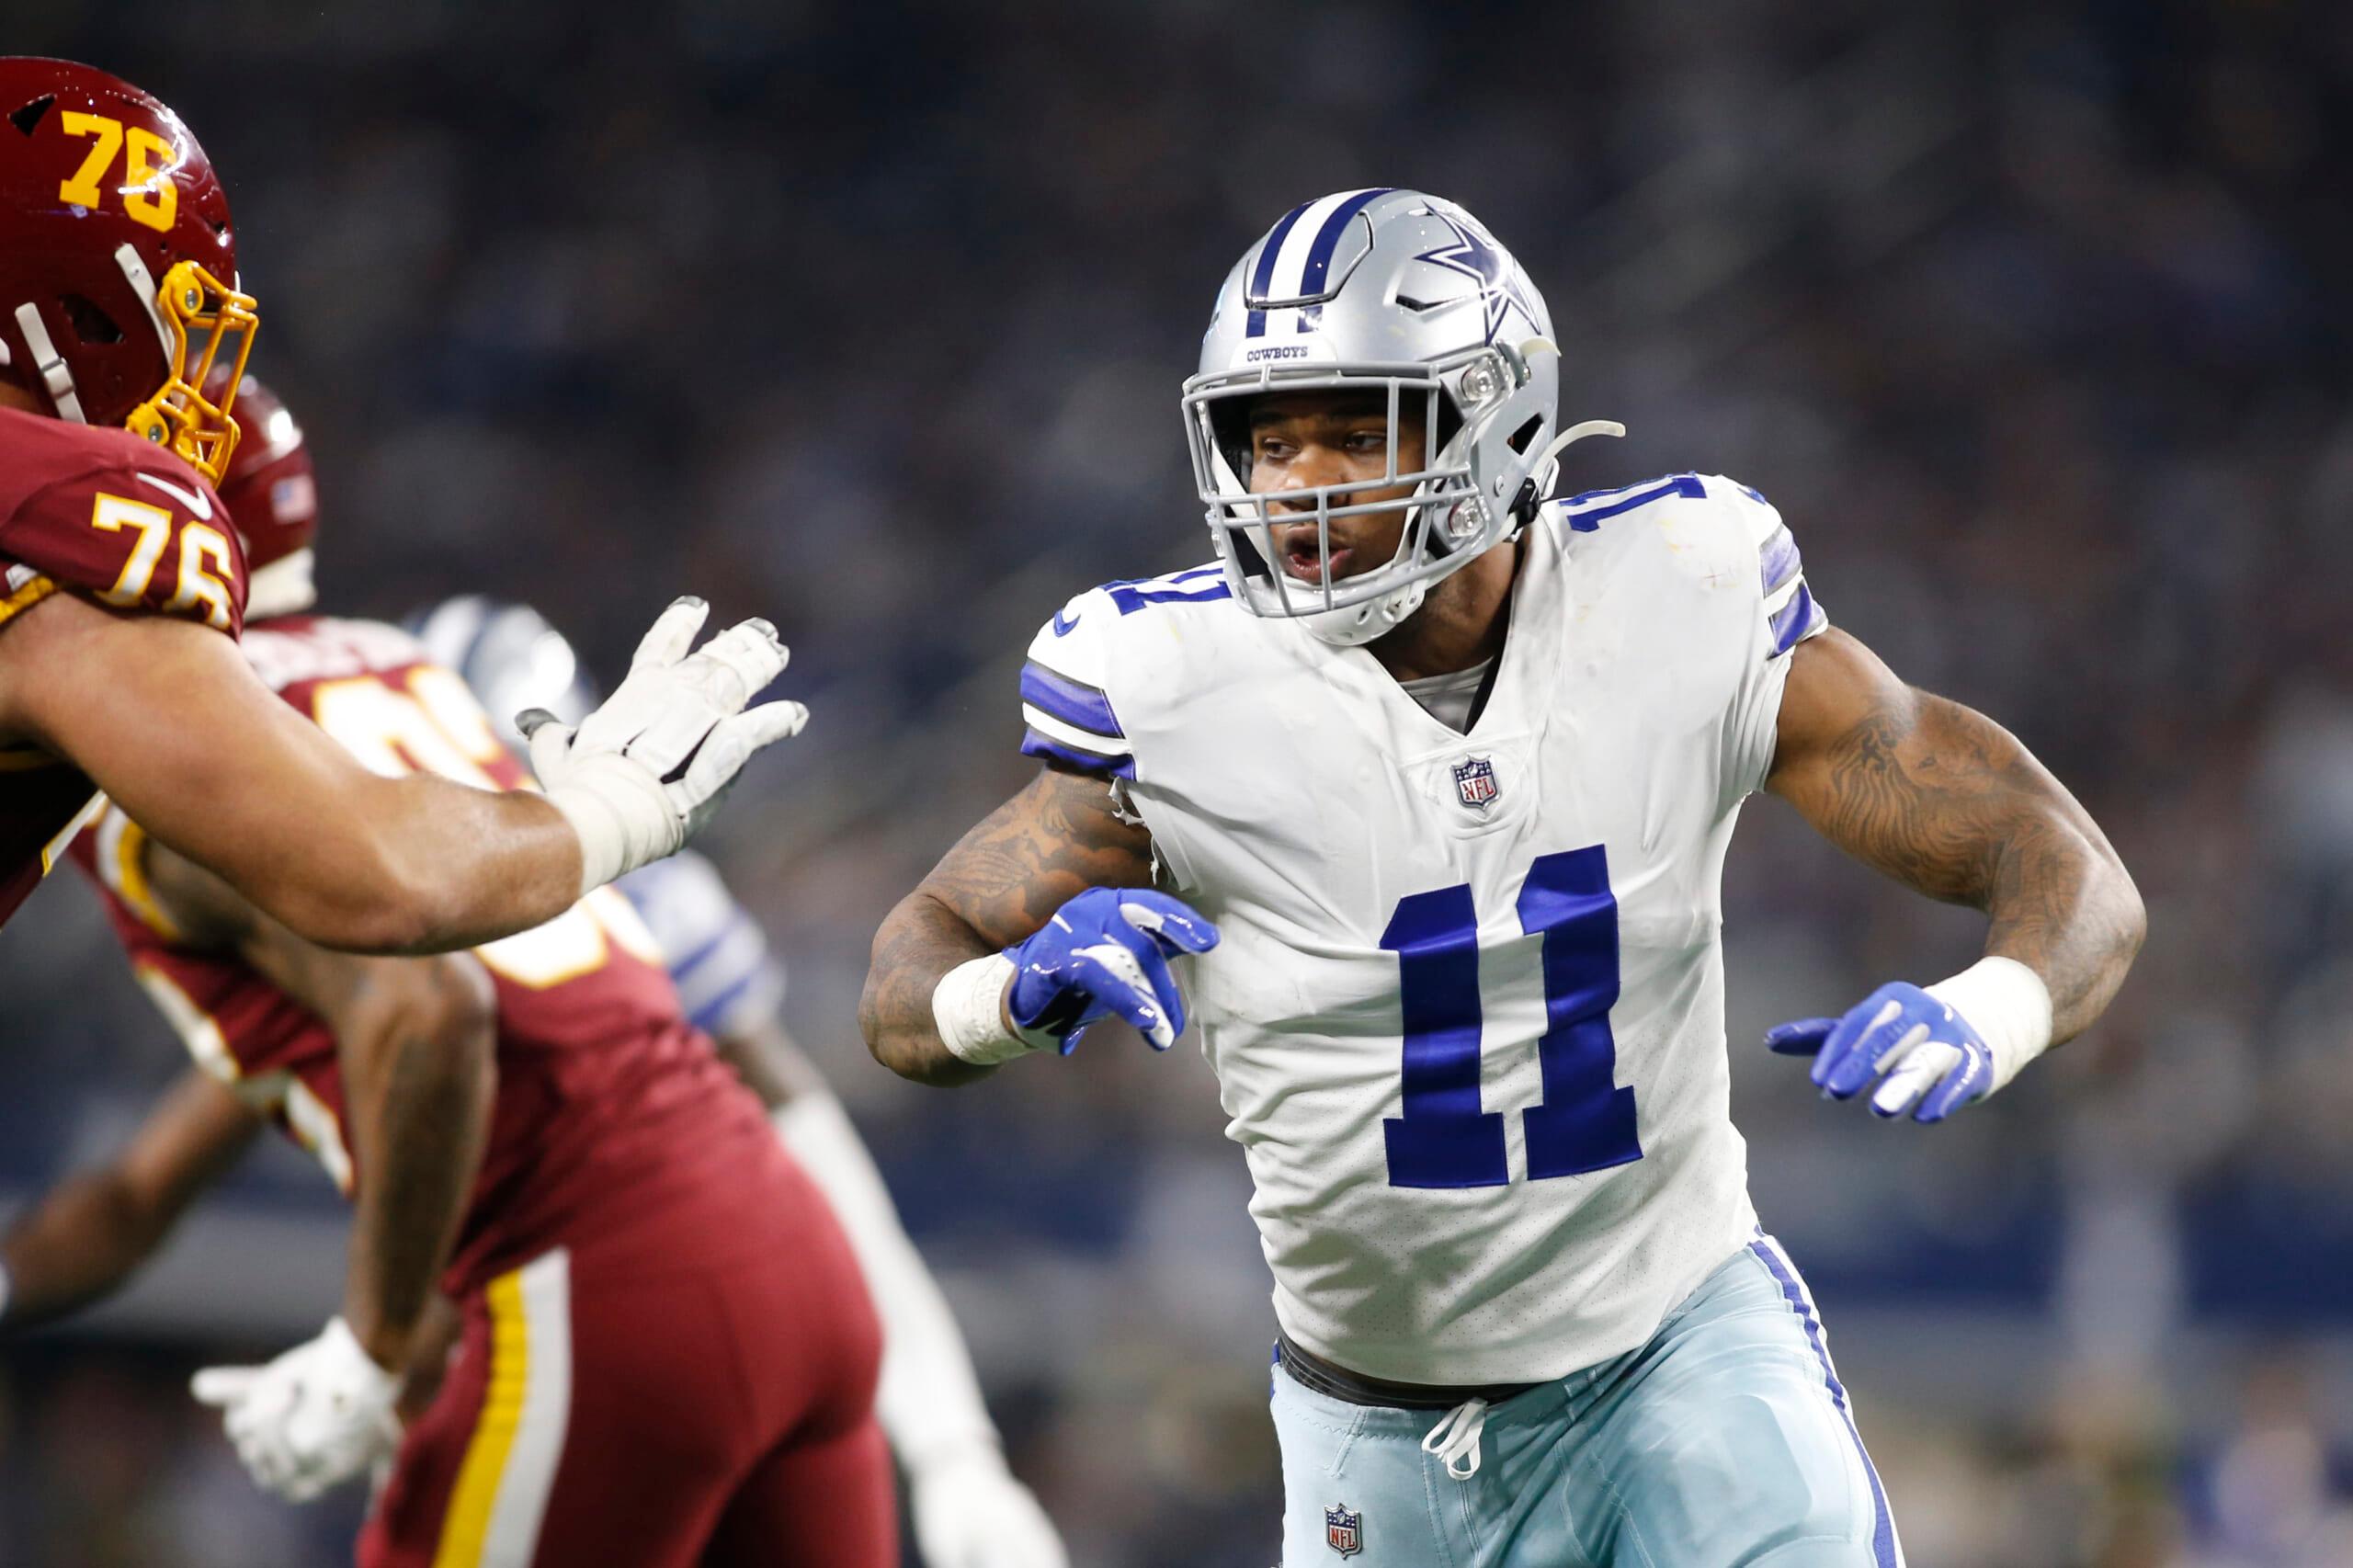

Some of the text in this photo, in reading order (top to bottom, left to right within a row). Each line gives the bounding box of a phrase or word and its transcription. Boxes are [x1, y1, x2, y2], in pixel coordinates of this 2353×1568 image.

[60, 109, 179, 233] 76
[1246, 346, 1308, 362] COWBOYS
[93, 492, 234, 631] 76
[1461, 778, 1495, 801] NFL
[1379, 843, 1644, 1189] 11
[1330, 1528, 1356, 1549] NFL
